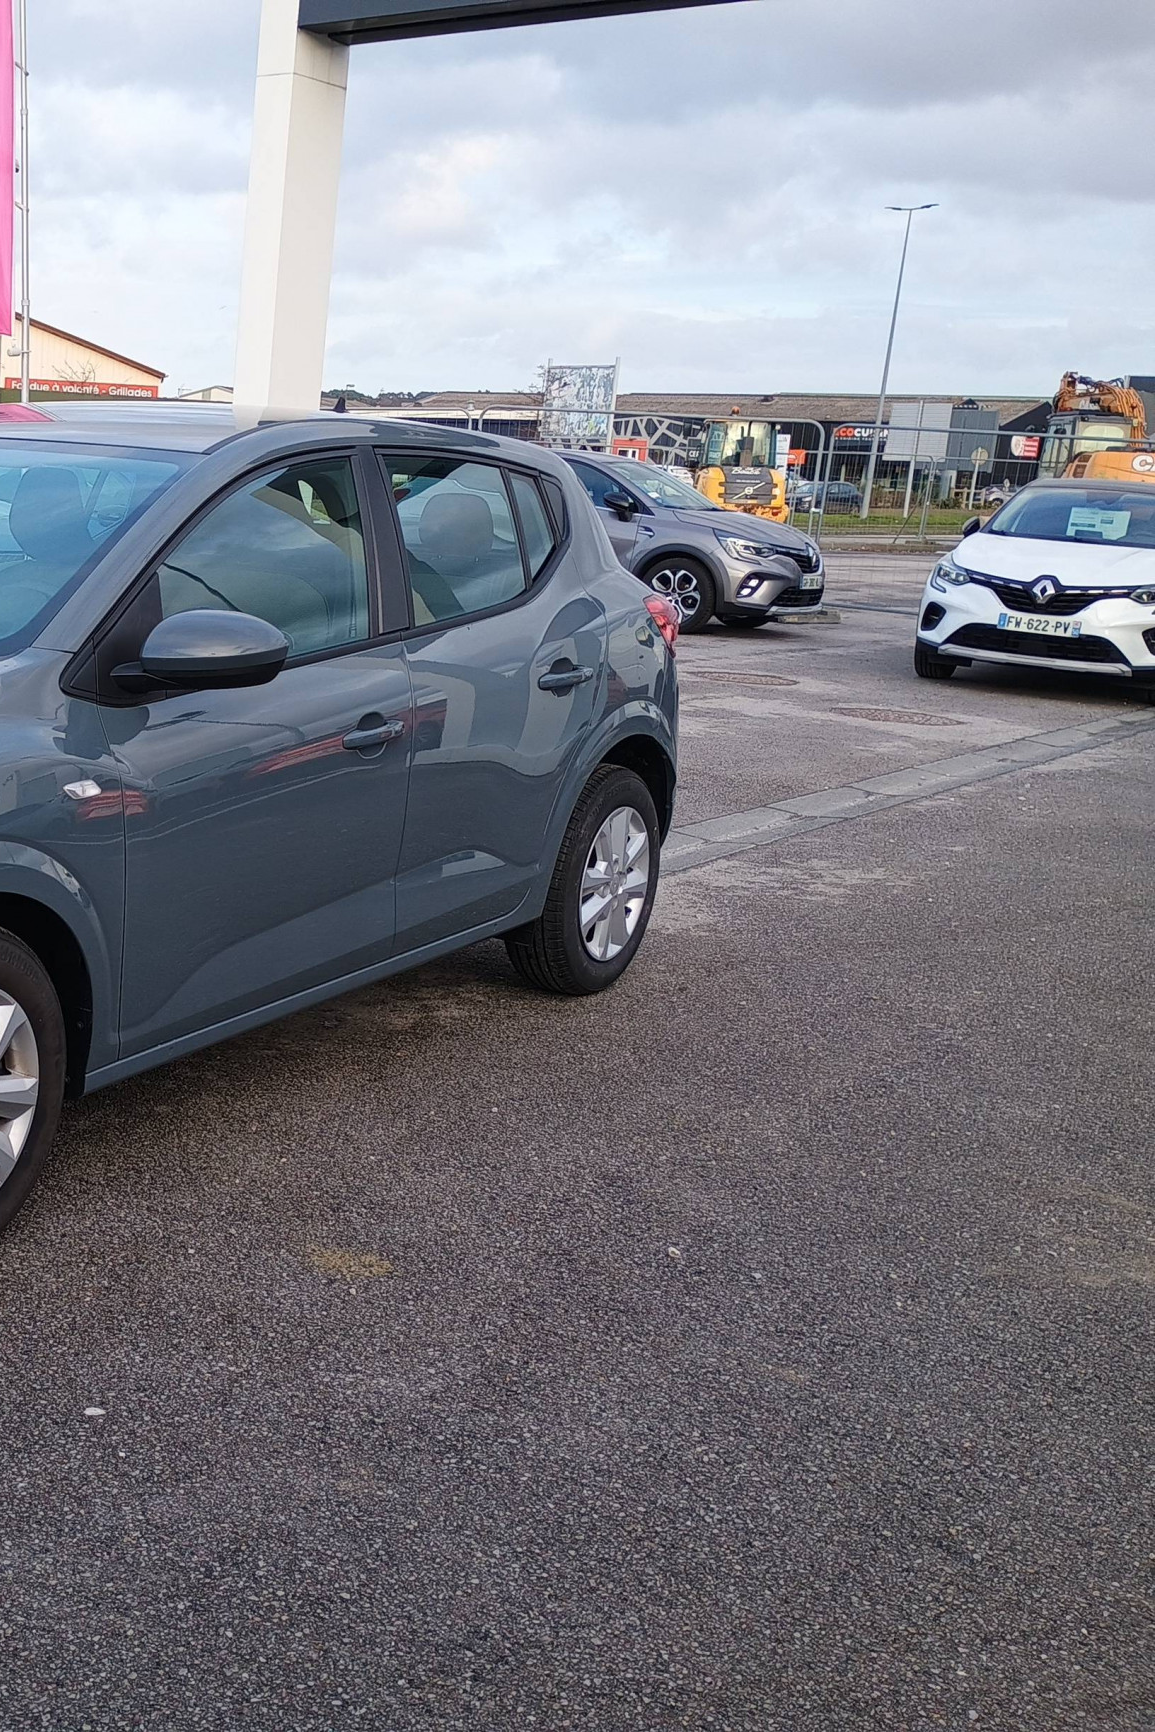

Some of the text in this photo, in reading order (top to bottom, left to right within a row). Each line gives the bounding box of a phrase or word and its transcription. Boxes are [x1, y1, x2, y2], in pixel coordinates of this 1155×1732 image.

[11, 380, 50, 392] Fodue
[52, 383, 60, 392] à
[109, 385, 152, 398] Grillades
[1132, 454, 1155, 473] C
[1006, 615, 1071, 635] FW-622-PV
